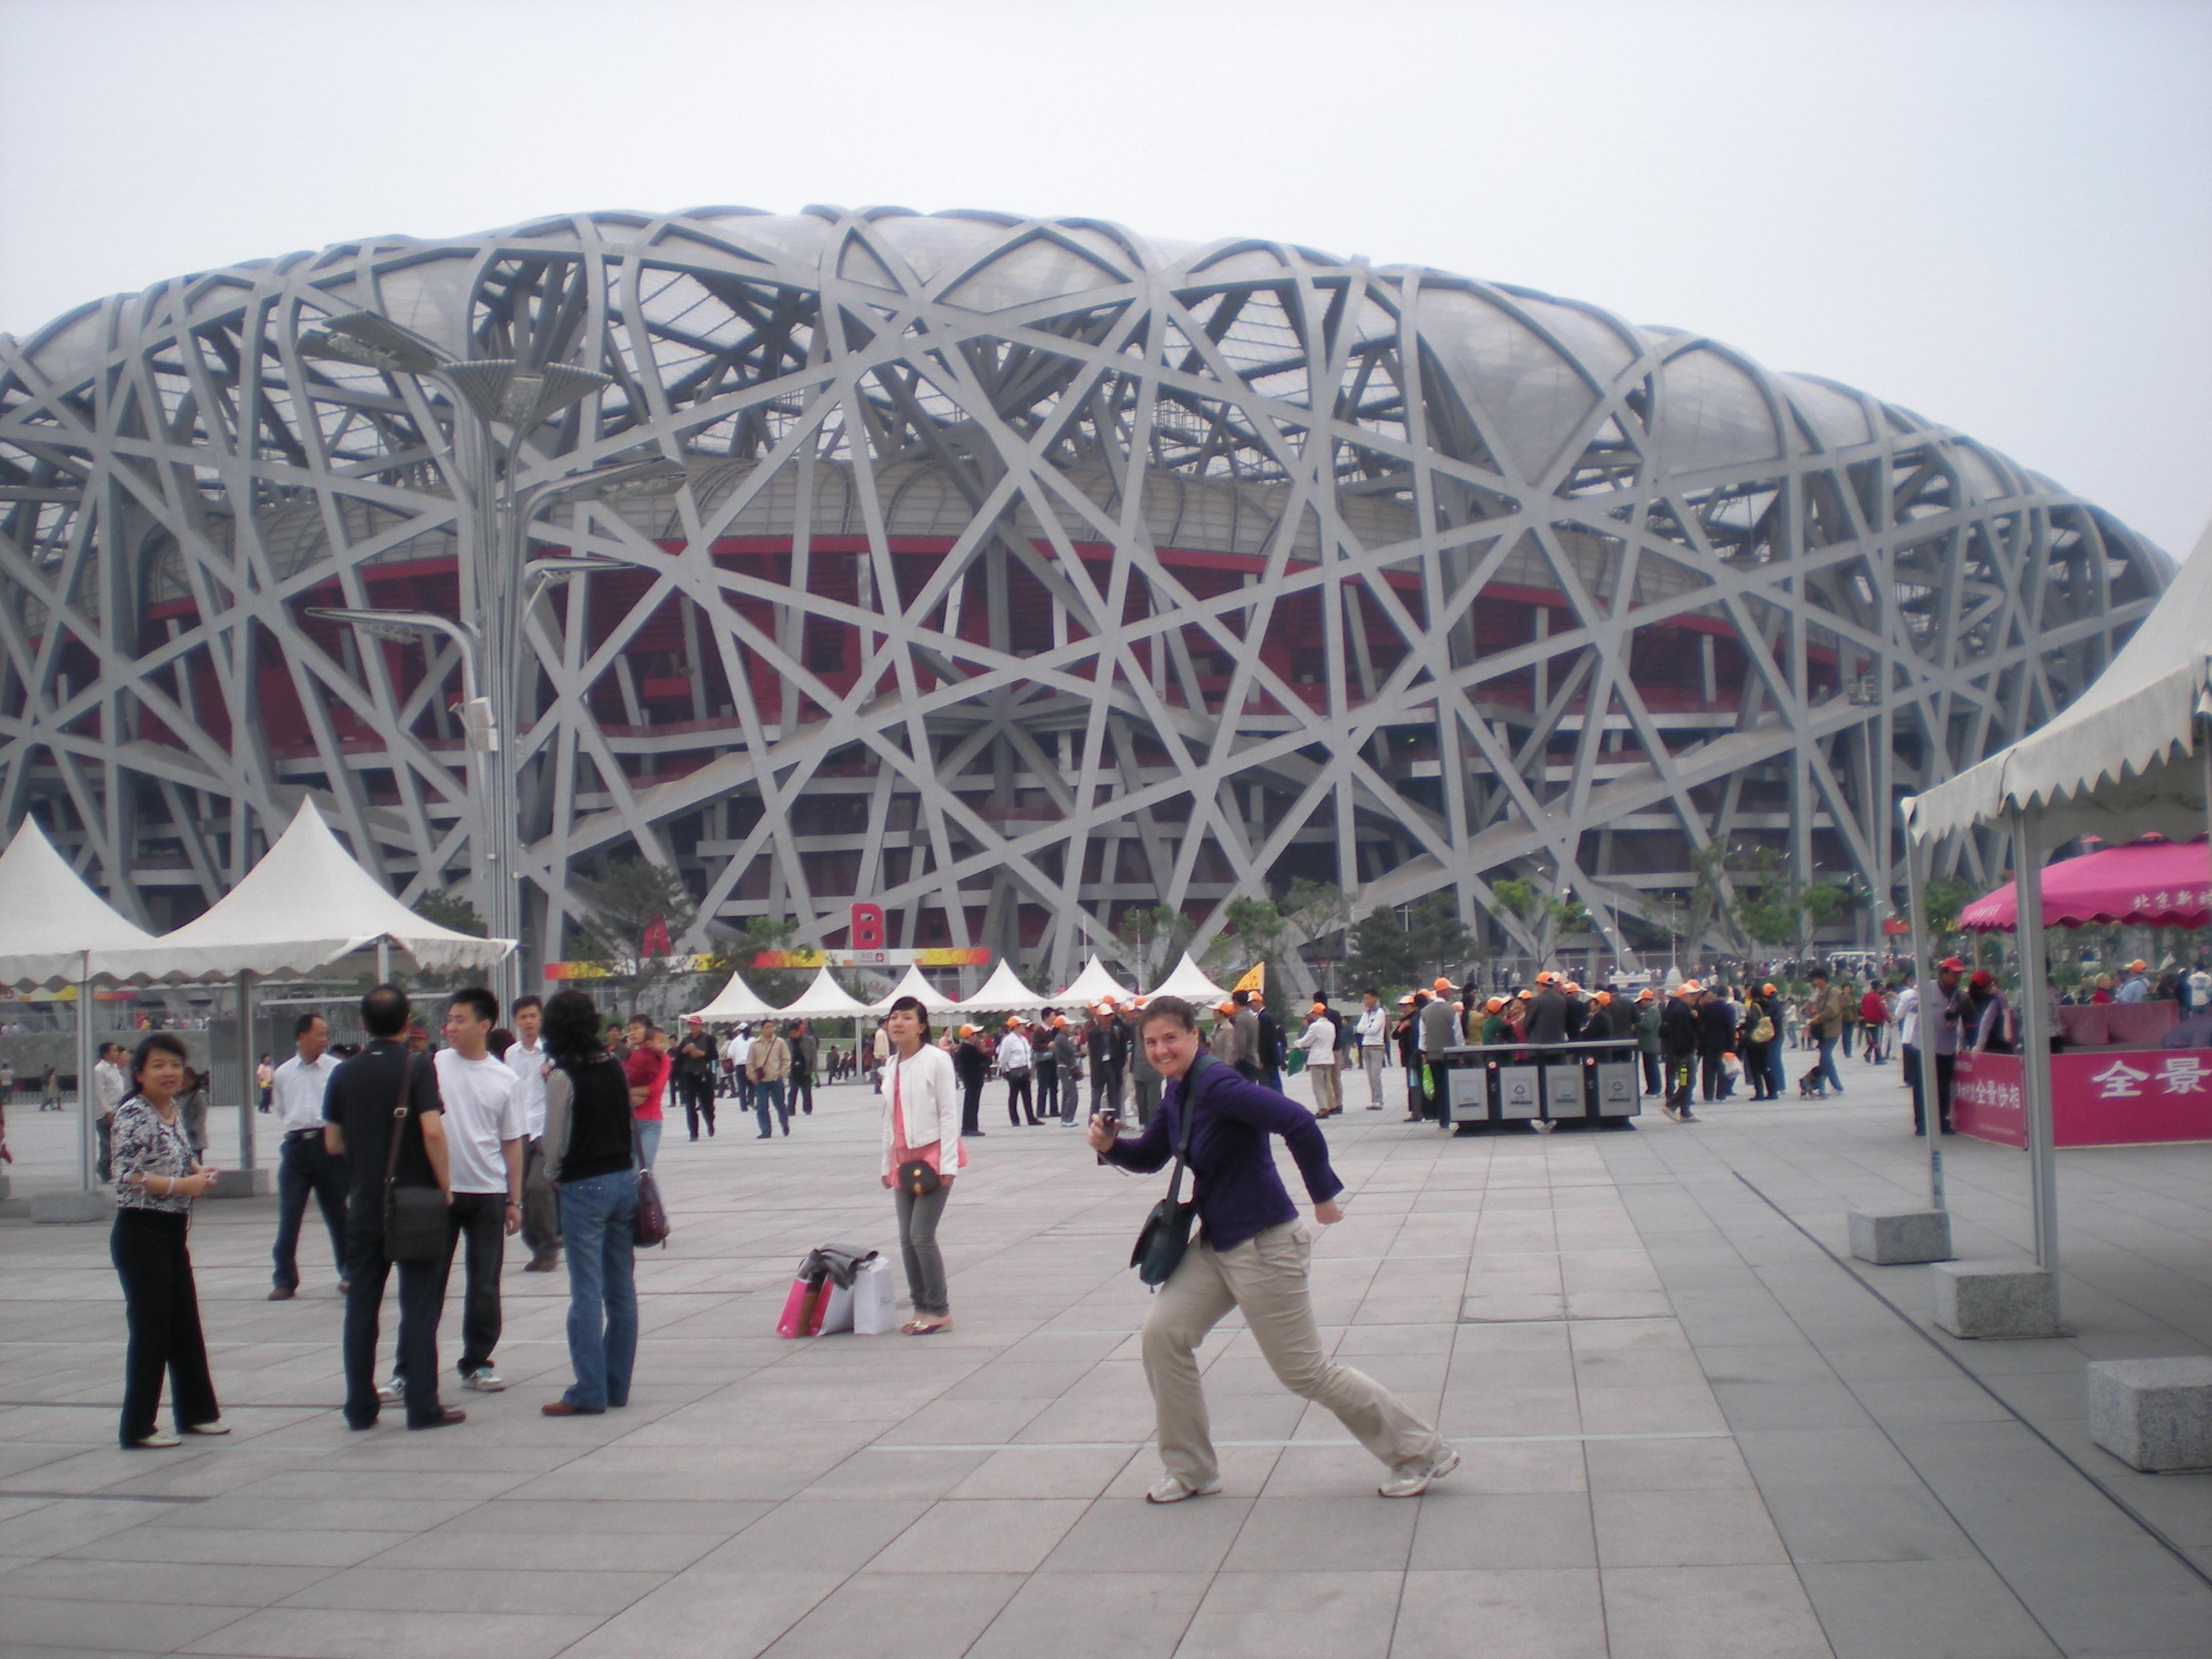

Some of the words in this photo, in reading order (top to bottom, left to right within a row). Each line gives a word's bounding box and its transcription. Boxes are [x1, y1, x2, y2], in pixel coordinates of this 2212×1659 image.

[642, 912, 671, 958] A
[851, 902, 884, 949] B
[2091, 1057, 2212, 1099] 全景
